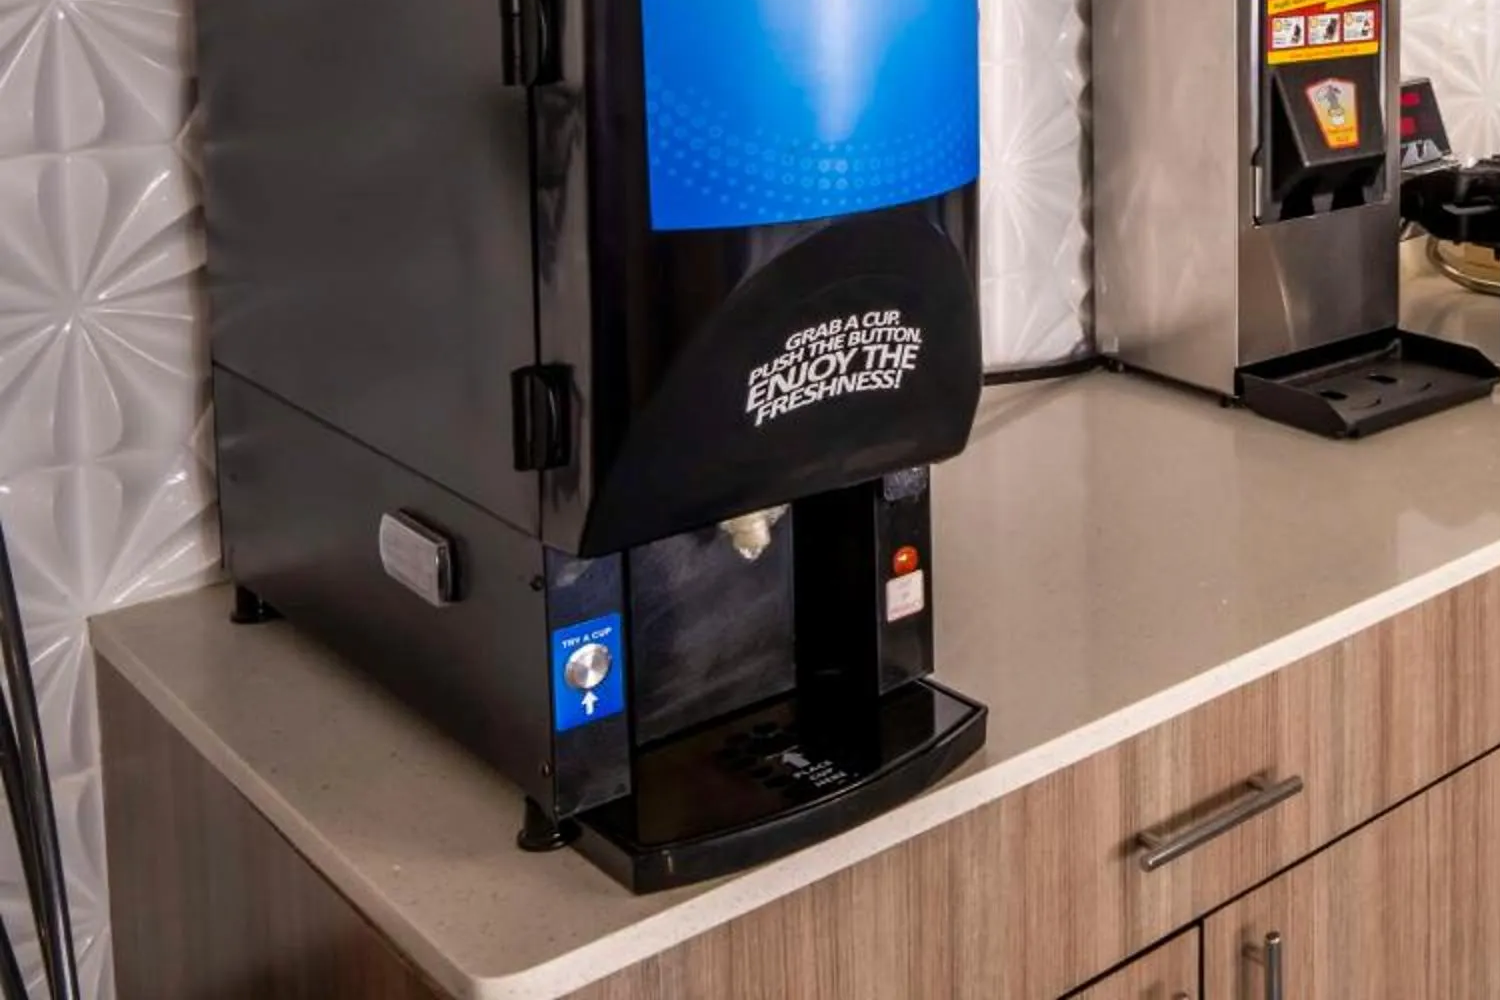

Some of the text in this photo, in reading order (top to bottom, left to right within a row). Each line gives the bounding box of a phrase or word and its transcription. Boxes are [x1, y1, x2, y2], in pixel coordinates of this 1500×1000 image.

[748, 326, 922, 386] PUSH THE BUTTON.
[785, 318, 842, 351] GRAB
[843, 314, 859, 331] A
[745, 343, 920, 414] ENJOY THE
[754, 368, 903, 427] FRESHNESS!
[561, 626, 613, 649] TRY A CUP
